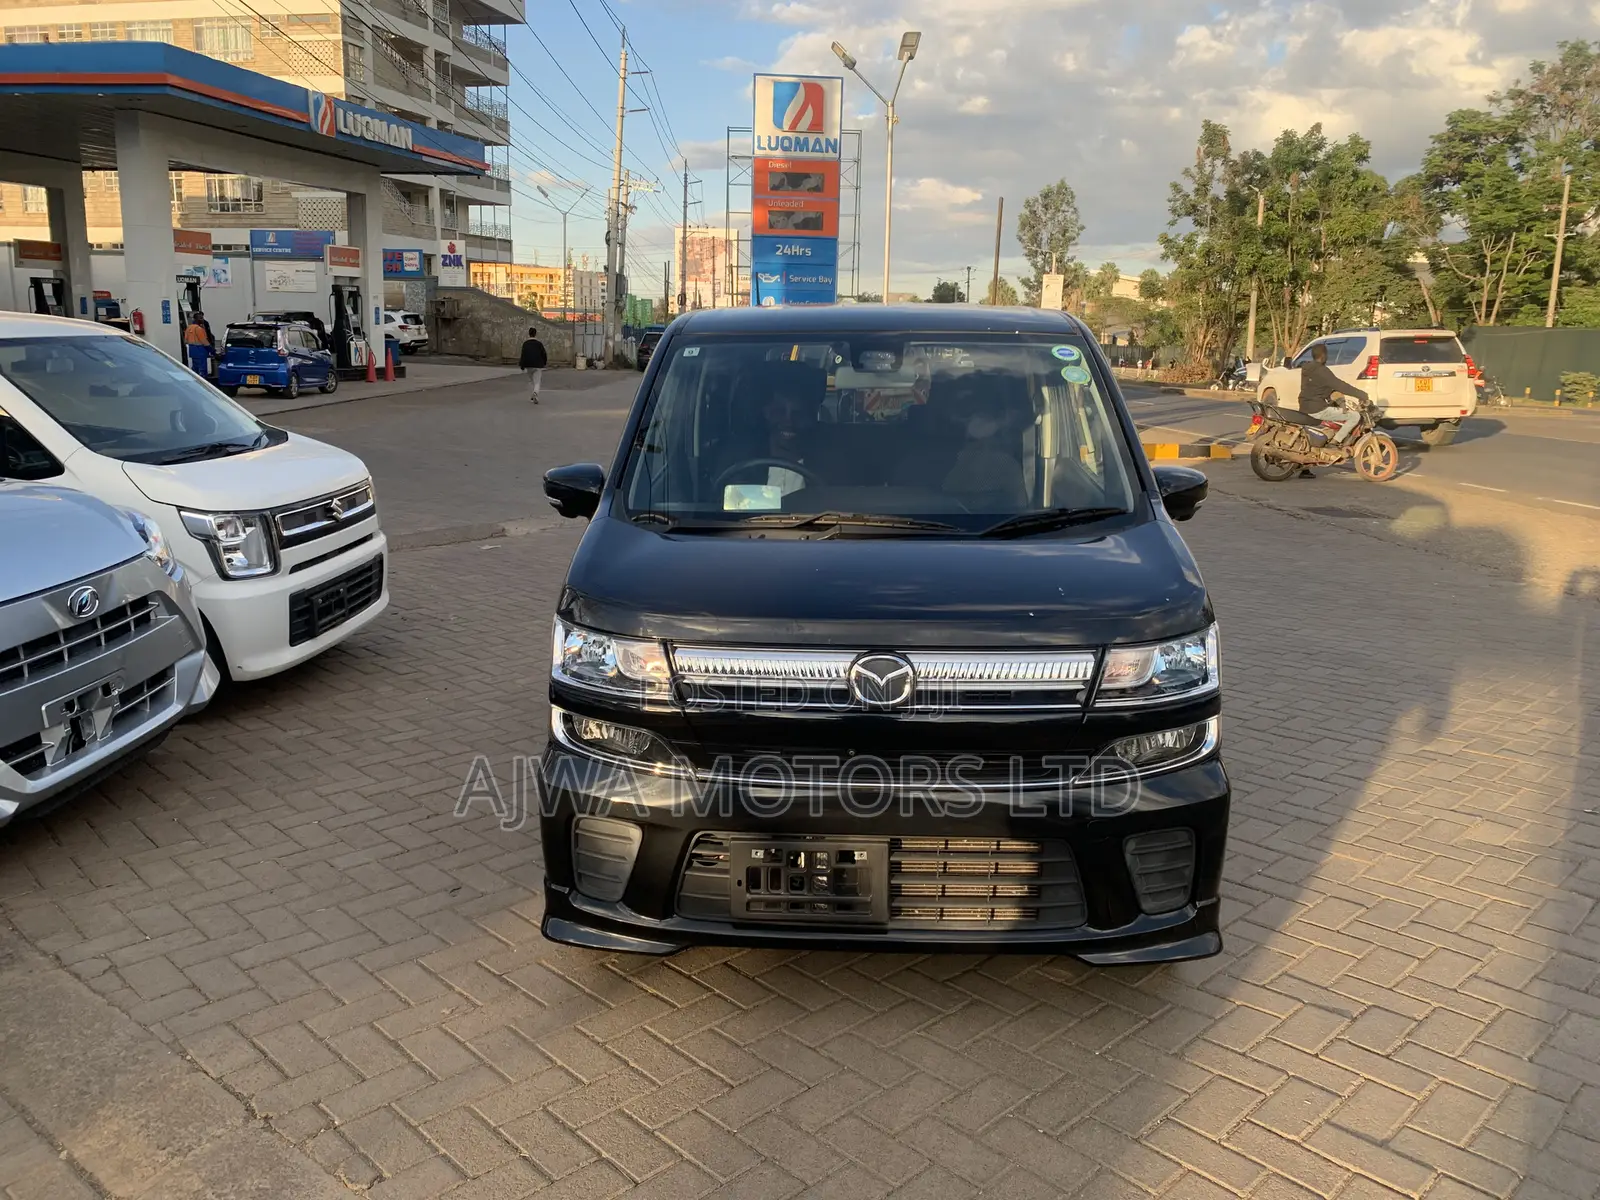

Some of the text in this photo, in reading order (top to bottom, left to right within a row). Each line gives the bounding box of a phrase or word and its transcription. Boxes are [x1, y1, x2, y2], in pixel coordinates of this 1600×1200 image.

[336, 107, 413, 151] LUQMAN
[756, 135, 838, 154] LUQMAN
[768, 160, 792, 169] Diesel
[768, 200, 804, 208] Unleaded
[775, 244, 812, 257] 24Hrs
[441, 254, 464, 267] ZNK
[789, 274, 833, 285] Service Bay
